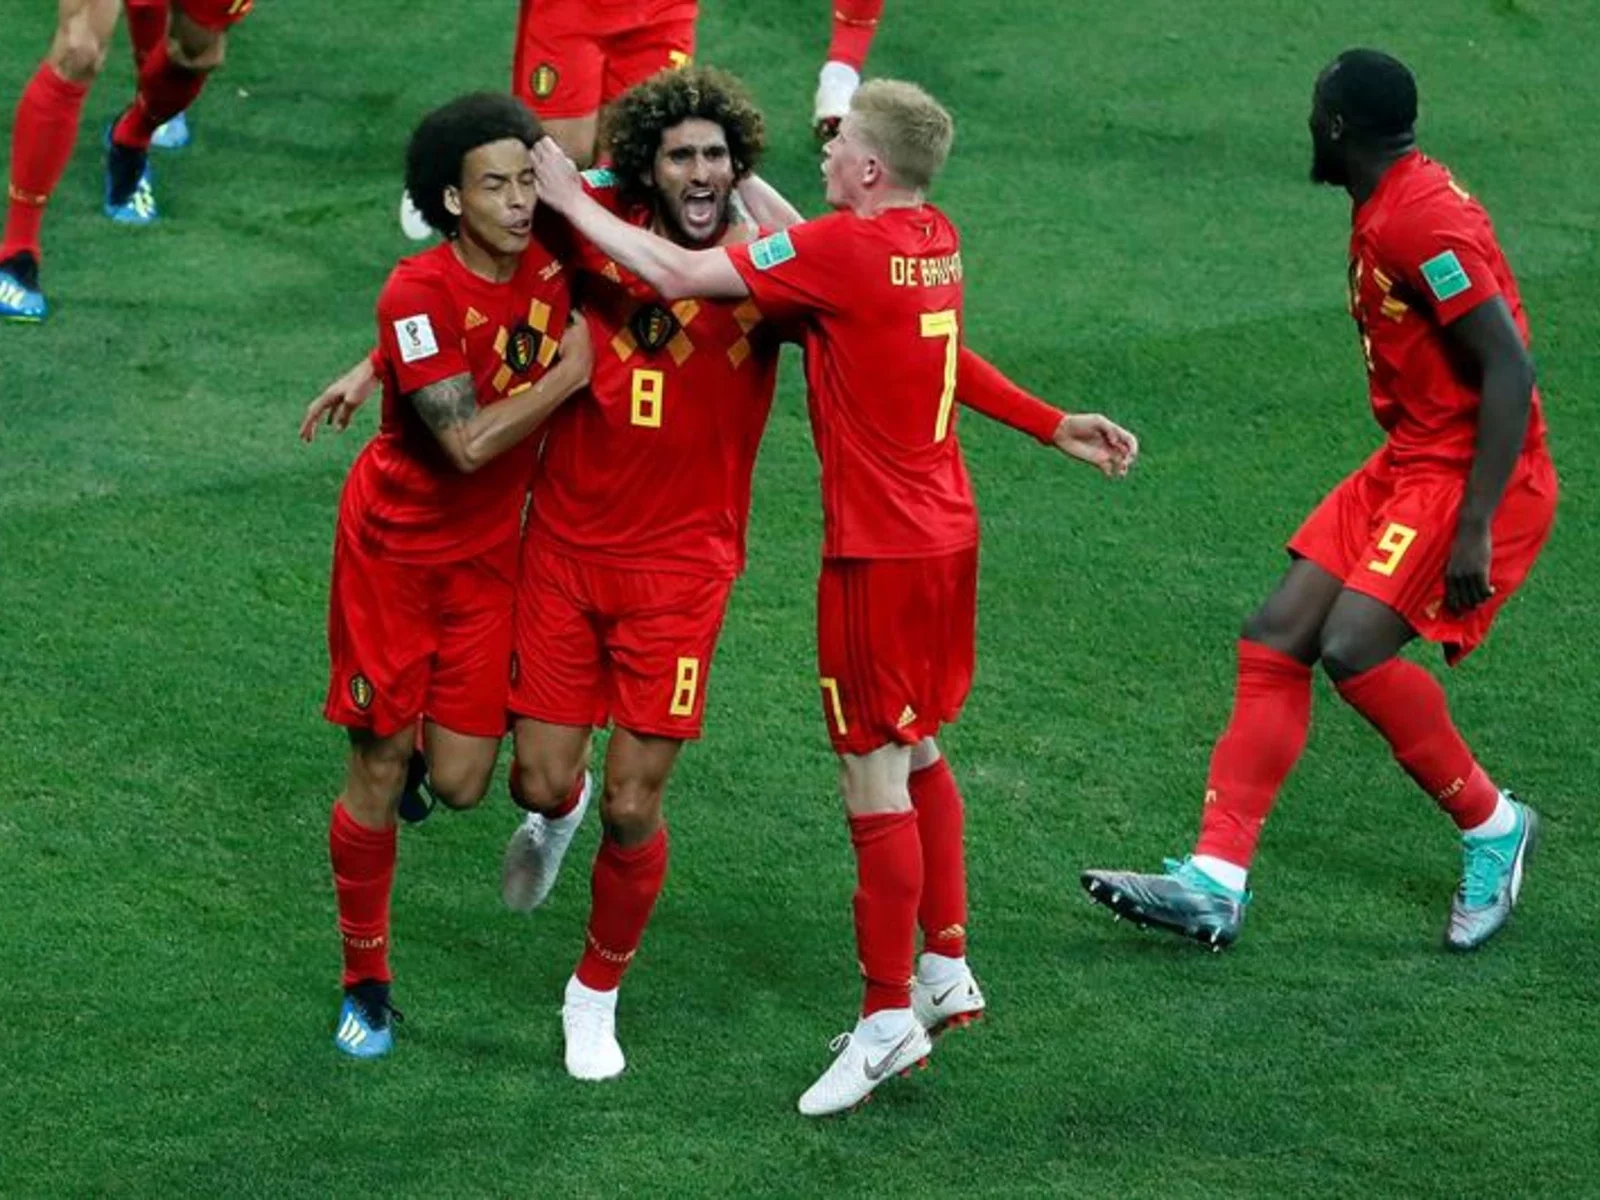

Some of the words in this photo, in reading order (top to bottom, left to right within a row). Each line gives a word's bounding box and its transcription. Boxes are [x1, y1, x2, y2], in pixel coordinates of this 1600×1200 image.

[890, 255, 918, 287] DE
[630, 368, 663, 428] 8
[919, 309, 958, 443] 7
[1367, 521, 1418, 577] 9
[669, 656, 700, 716] 8
